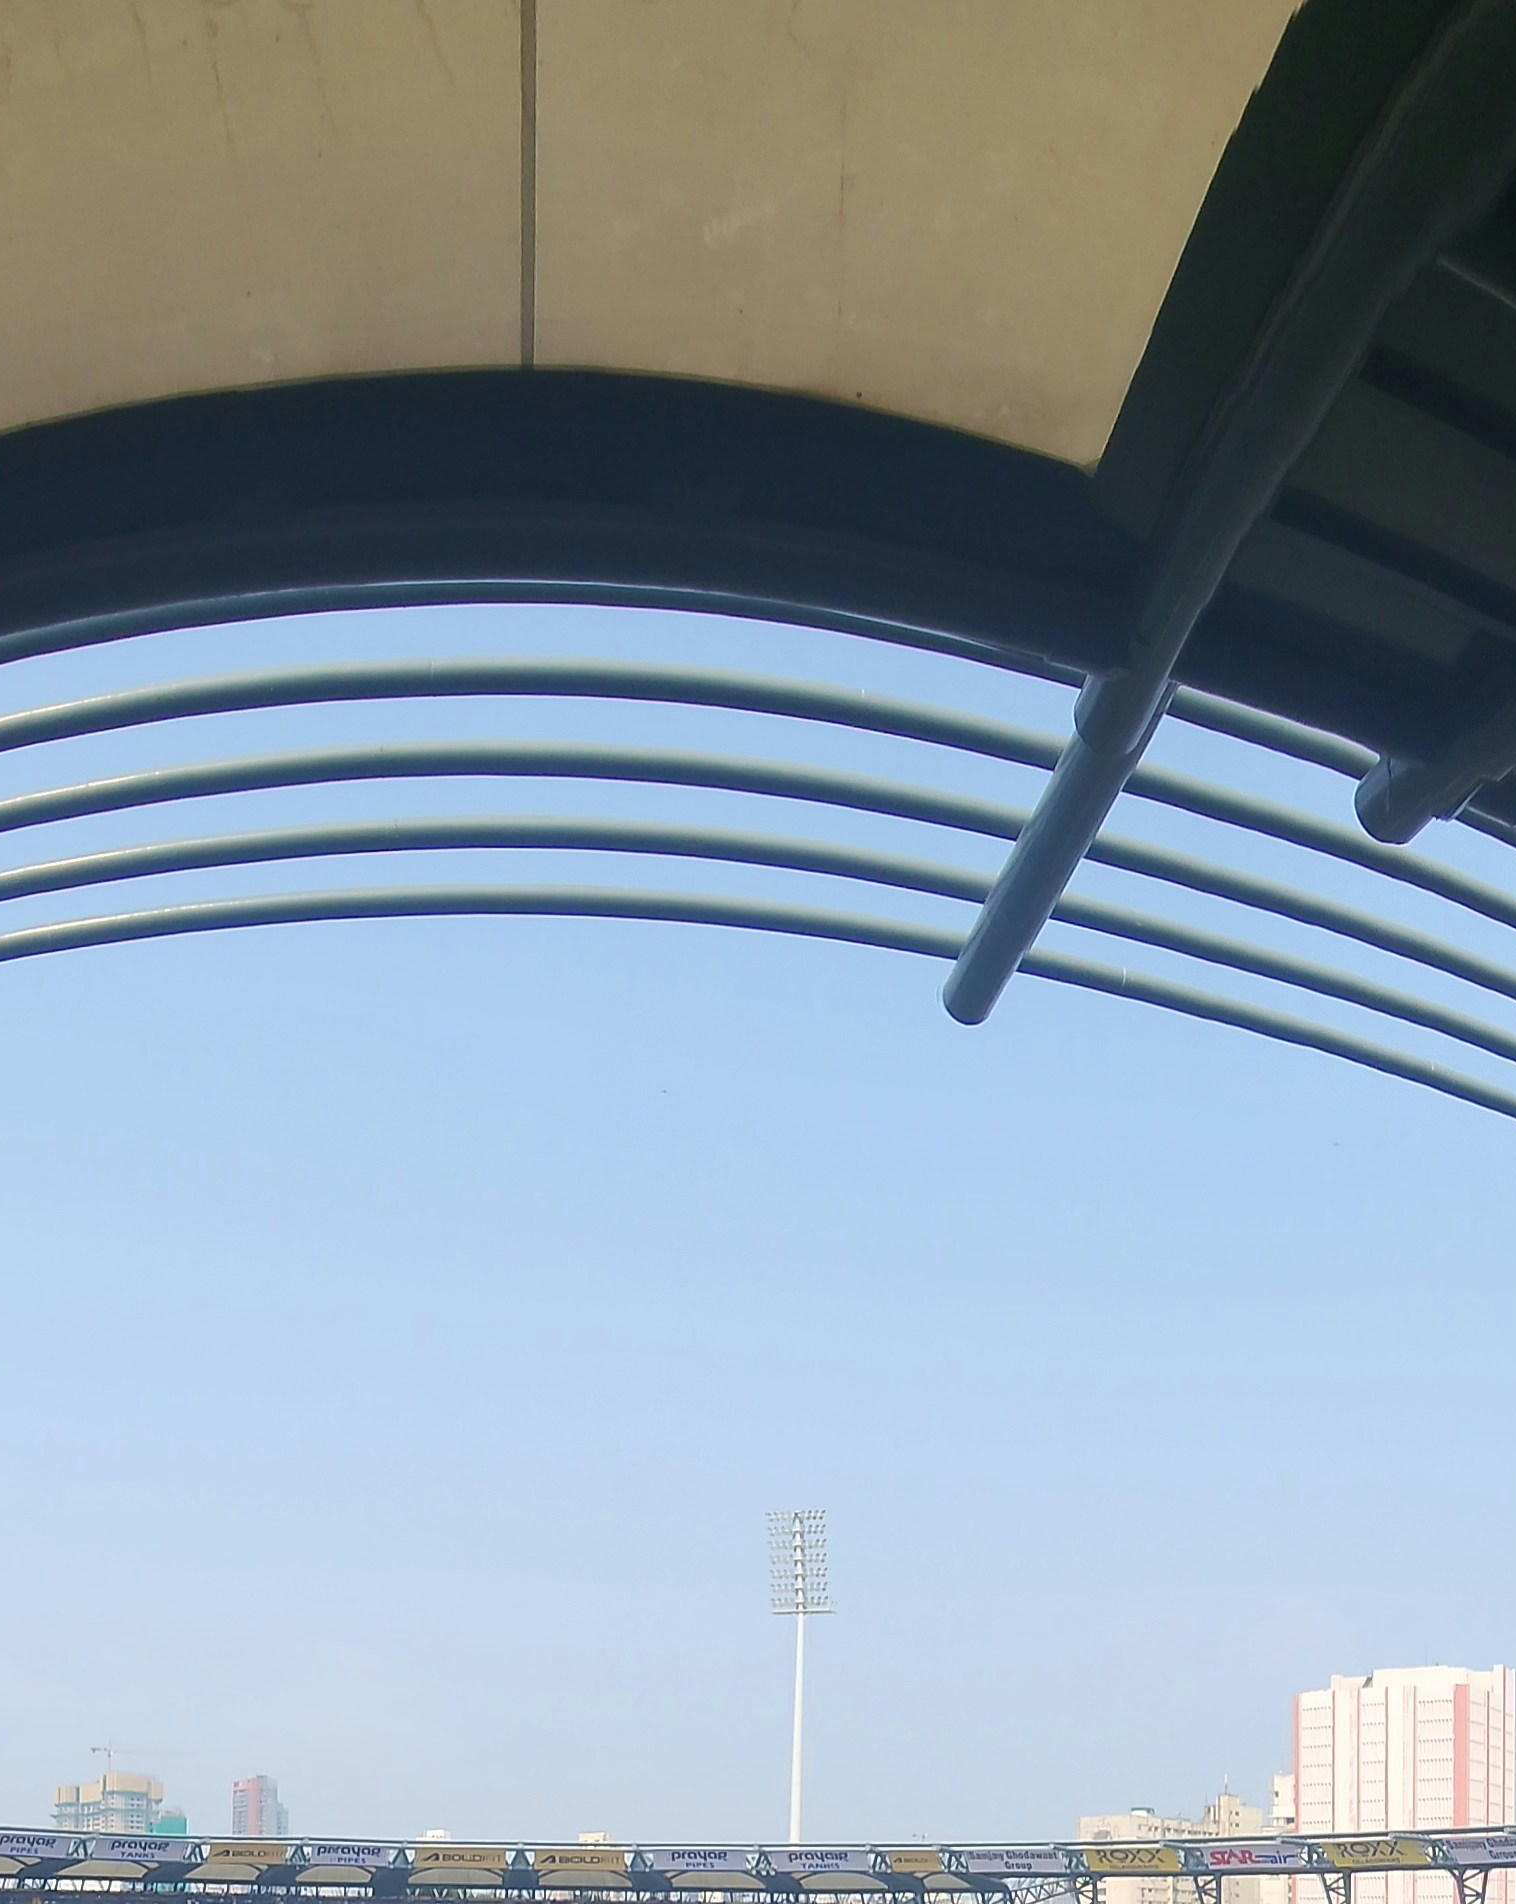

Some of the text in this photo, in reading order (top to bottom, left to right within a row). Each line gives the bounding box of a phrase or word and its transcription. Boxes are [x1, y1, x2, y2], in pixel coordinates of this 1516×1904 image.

[1096, 1848, 1165, 1863] ROXX
[1337, 1839, 1405, 1858] ROXX
[1005, 1861, 1032, 1871] Group
